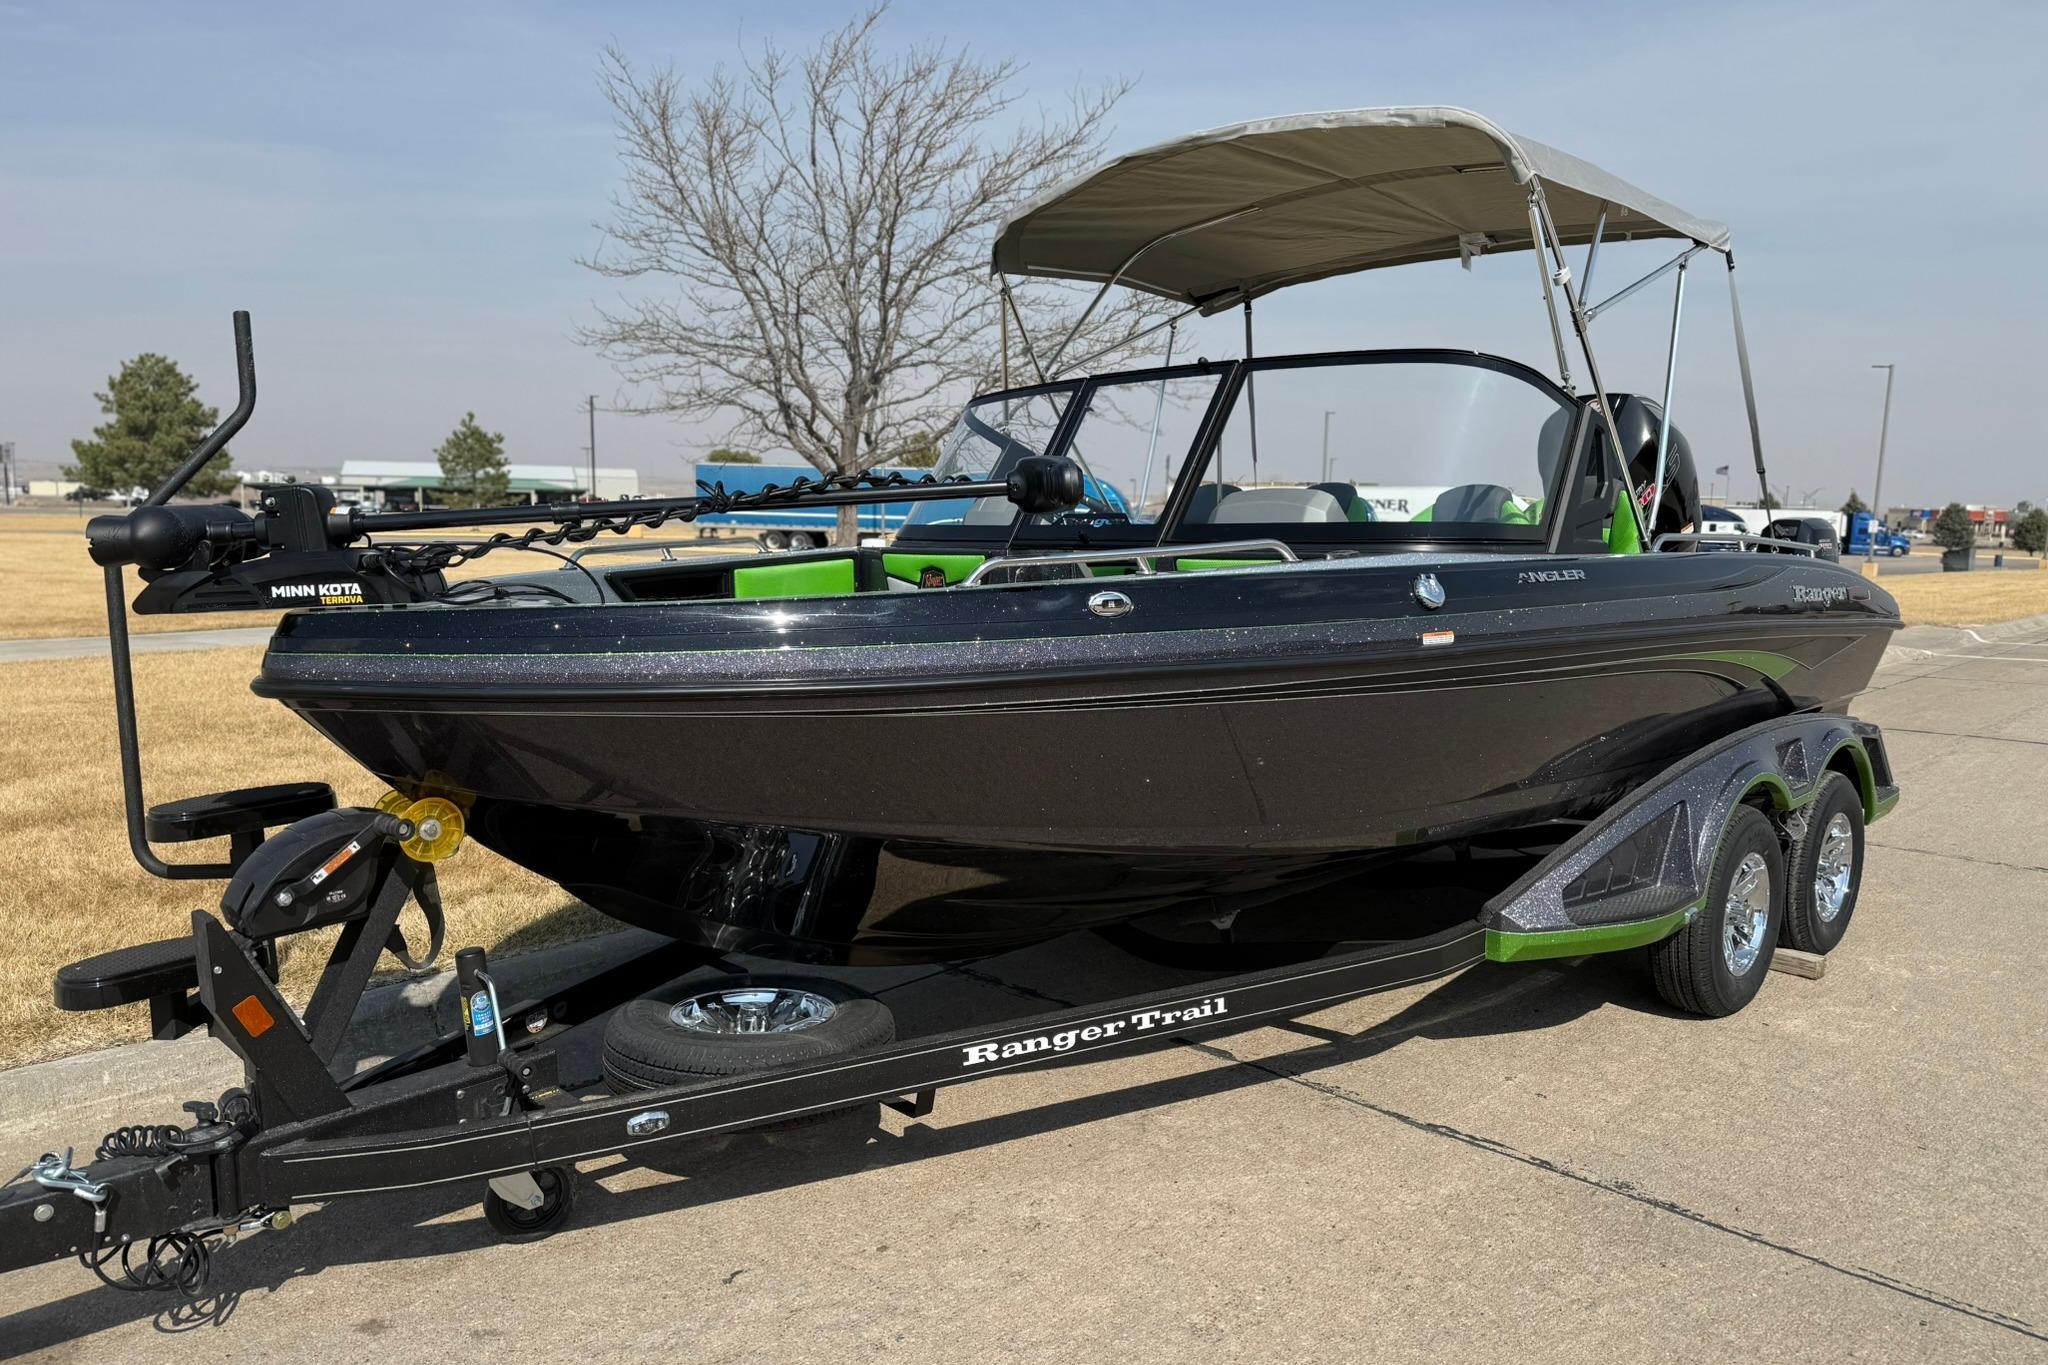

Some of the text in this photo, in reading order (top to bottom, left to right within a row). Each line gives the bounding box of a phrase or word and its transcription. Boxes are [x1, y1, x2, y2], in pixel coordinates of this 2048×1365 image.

[1518, 569, 1587, 584] ANGLER
[271, 583, 362, 597] MINN KOTA
[1792, 584, 1848, 607] Ranger
[320, 595, 363, 605] TERROVA
[962, 997, 1228, 1066] Ranger Trail
